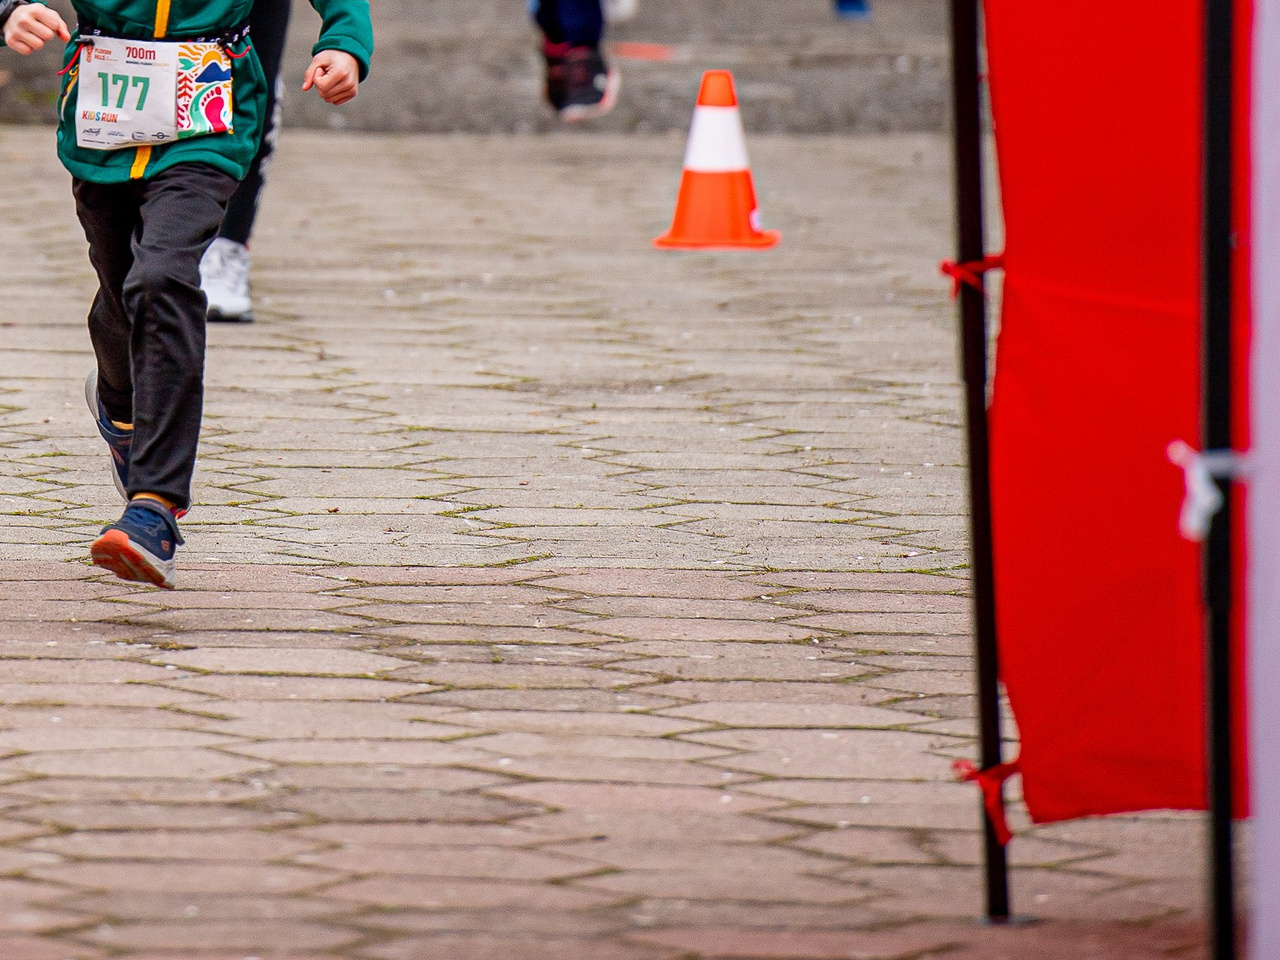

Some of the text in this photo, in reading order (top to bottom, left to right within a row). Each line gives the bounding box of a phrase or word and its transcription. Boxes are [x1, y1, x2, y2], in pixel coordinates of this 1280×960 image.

[125, 46, 156, 60] 700m
[98, 71, 150, 111] 177
[82, 110, 119, 123] KIDS RUN
